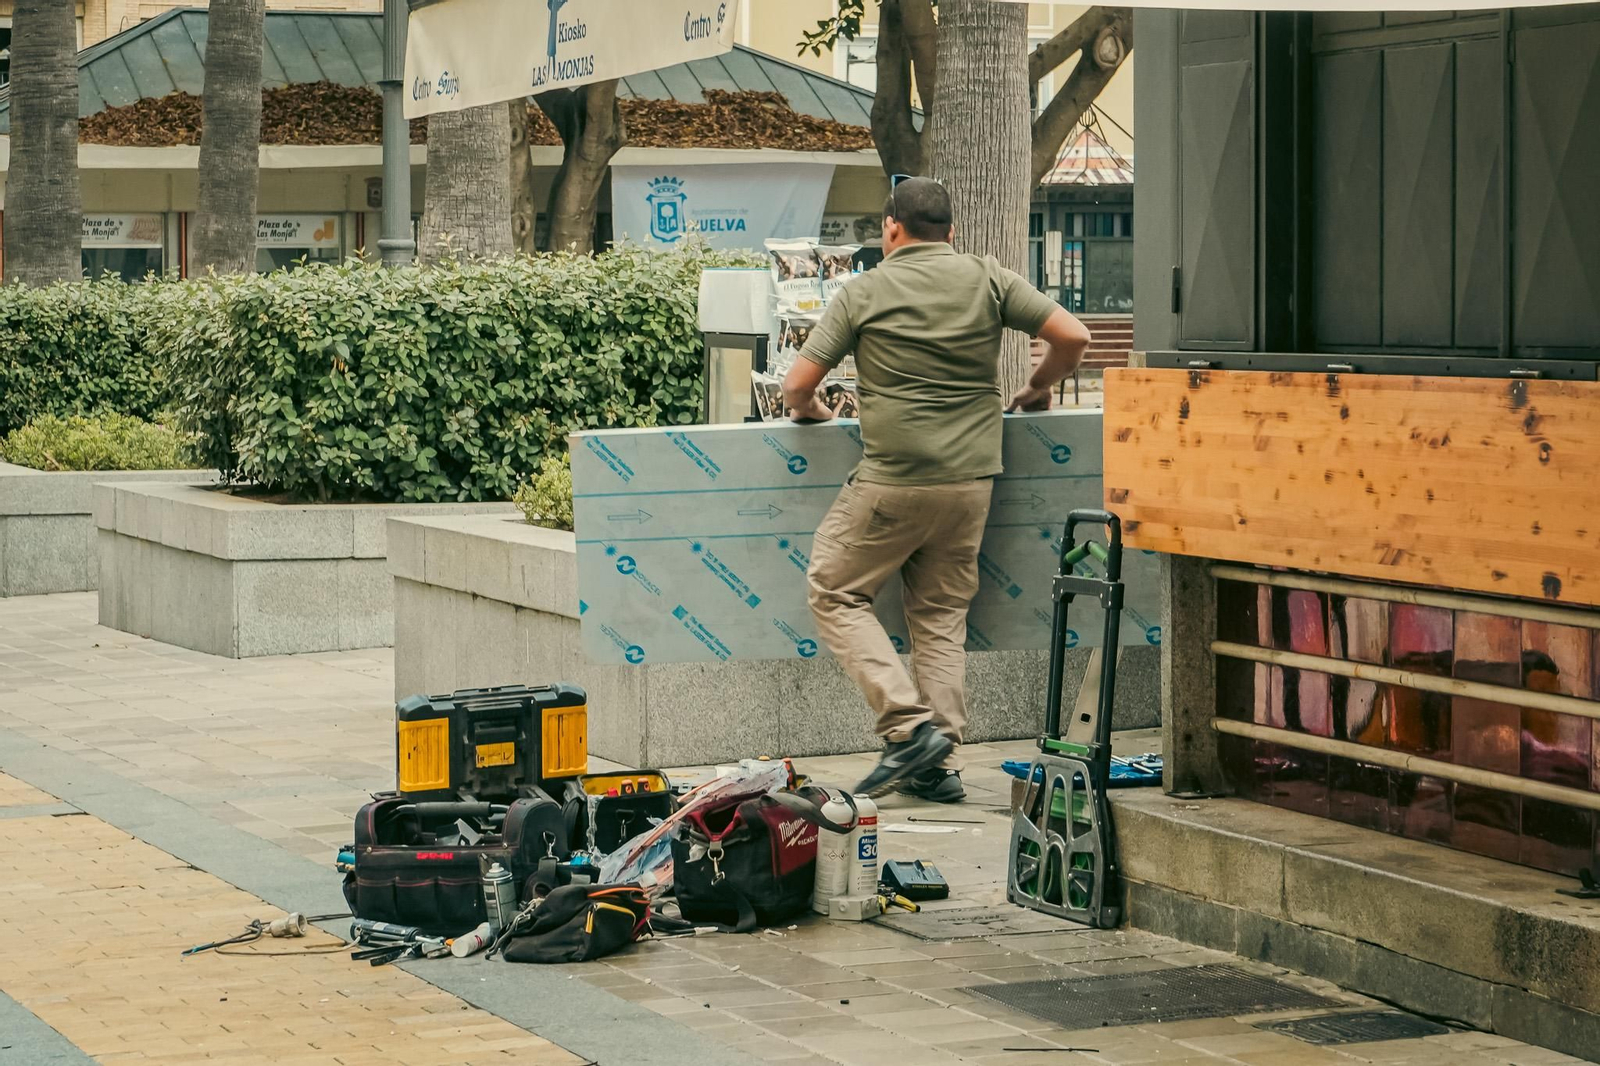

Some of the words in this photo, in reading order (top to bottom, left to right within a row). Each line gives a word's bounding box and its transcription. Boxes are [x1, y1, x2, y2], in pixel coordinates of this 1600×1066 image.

[558, 18, 587, 43] Kiosko
[684, 10, 711, 42] Centro
[532, 65, 547, 87] LAS
[556, 54, 594, 81] MONJAS
[104, 218, 115, 226] de
[258, 219, 280, 228] Plaza
[282, 219, 293, 228] de
[257, 229, 268, 238] Las
